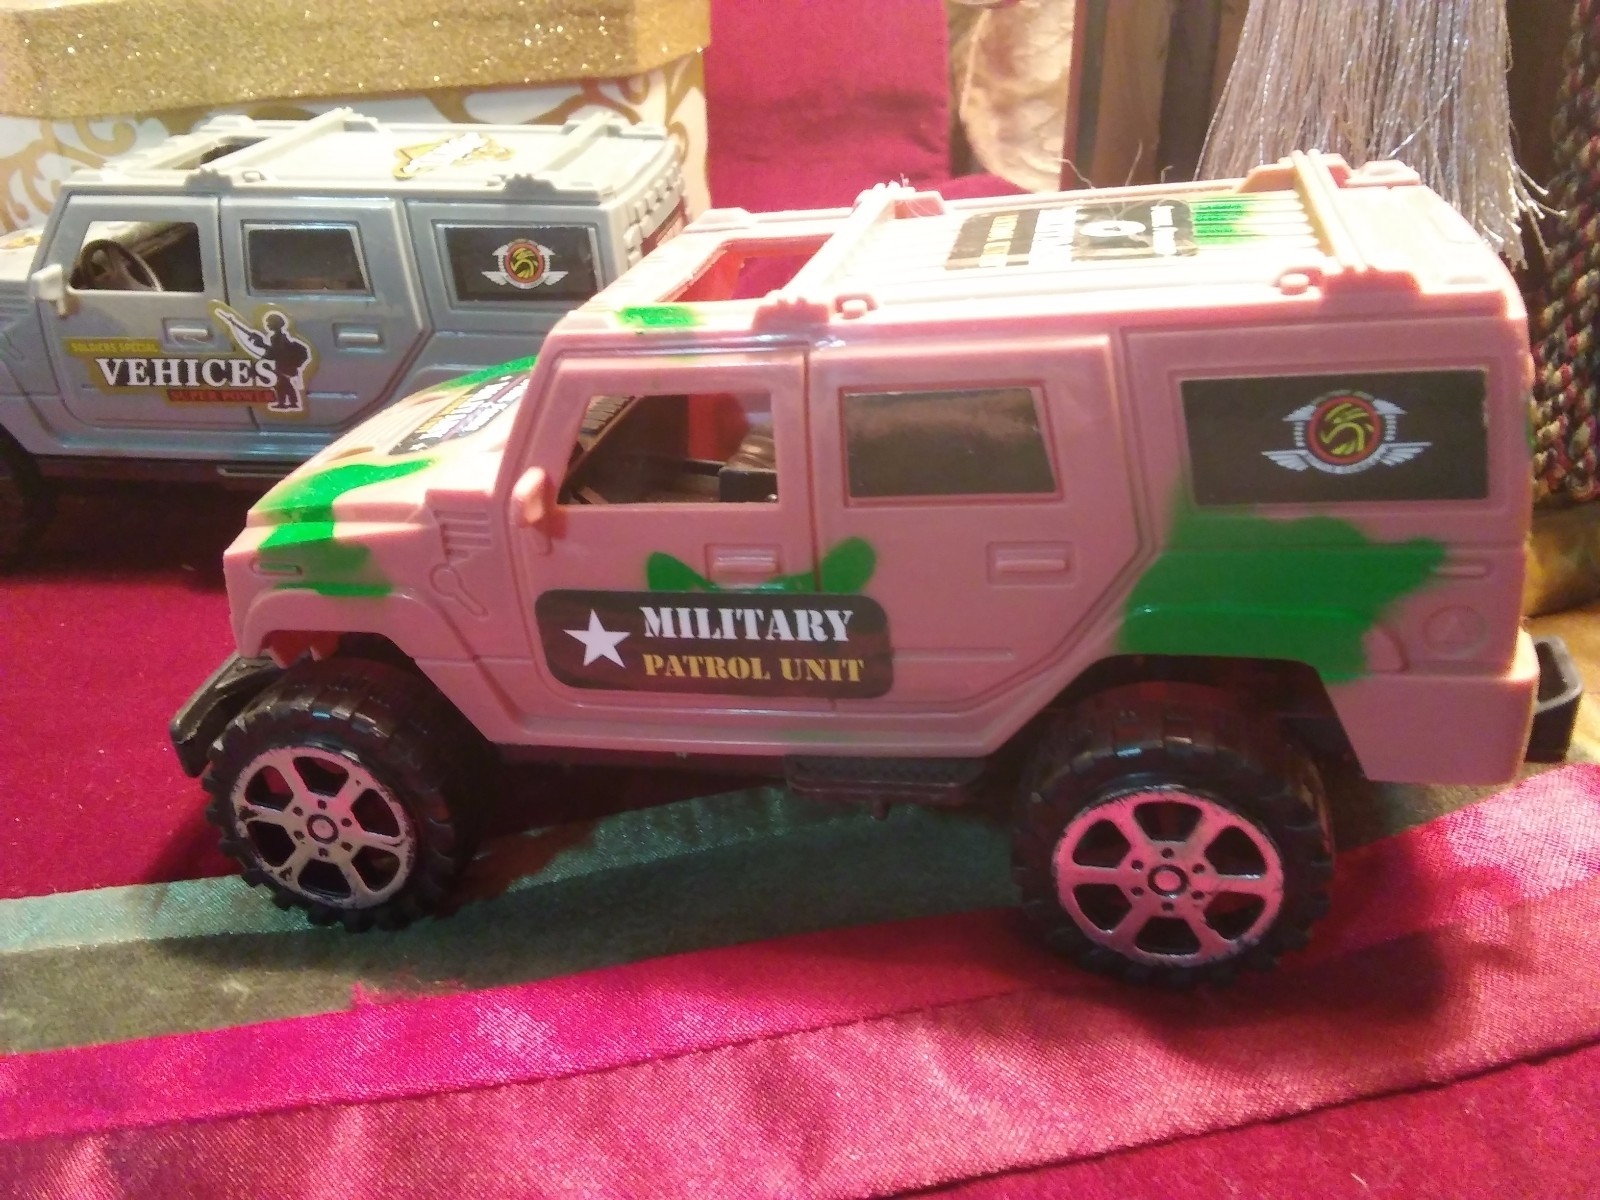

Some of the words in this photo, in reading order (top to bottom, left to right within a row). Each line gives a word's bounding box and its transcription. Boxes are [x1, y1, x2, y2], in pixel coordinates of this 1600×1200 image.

[96, 358, 278, 387] VEHICES
[639, 606, 854, 642] MILITARY
[642, 653, 771, 681] PATROL
[779, 657, 865, 683] UNIT
